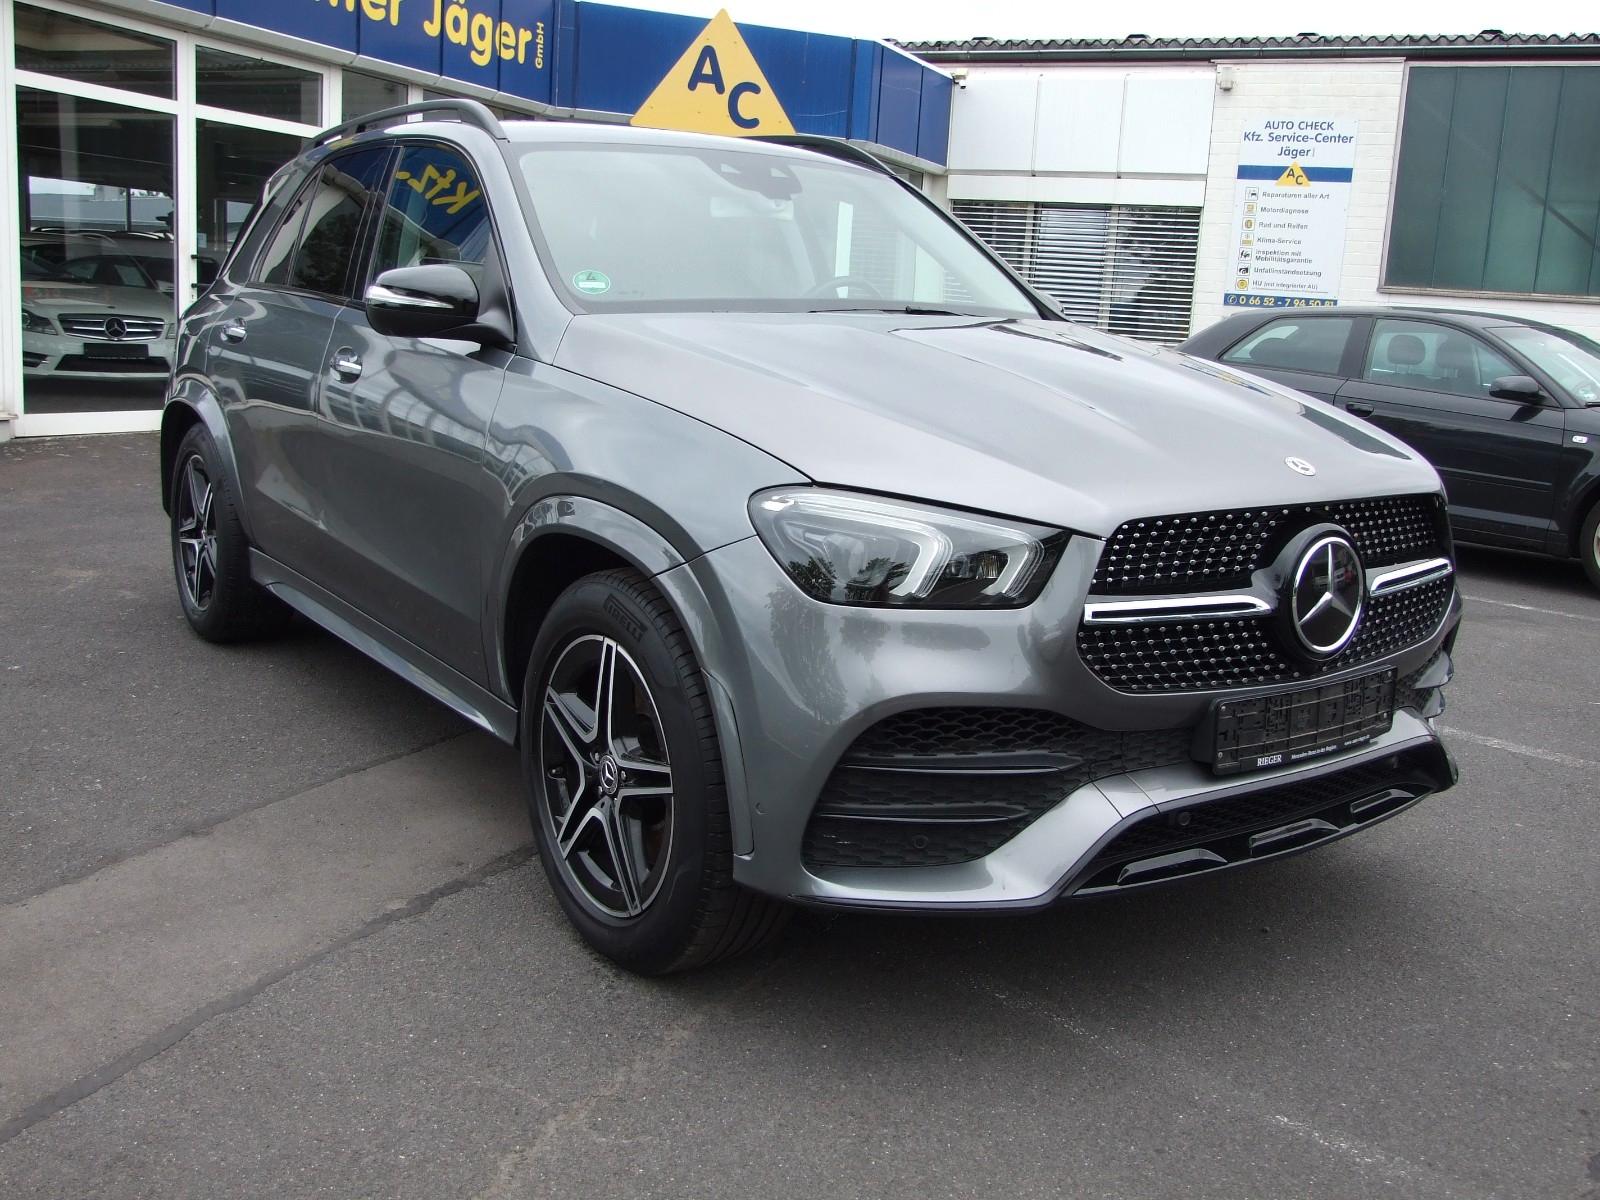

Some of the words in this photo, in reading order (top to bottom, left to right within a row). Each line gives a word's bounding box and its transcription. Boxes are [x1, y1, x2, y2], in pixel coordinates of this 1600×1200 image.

[423, 0, 532, 66] Jäger
[535, 22, 545, 69] GmbH
[1264, 121, 1294, 130] AUTO
[1298, 121, 1334, 131] CHECK
[1243, 131, 1264, 142] Kfz.
[1267, 132, 1354, 144] Service-Center
[1277, 146, 1311, 159] Jäger
[1262, 191, 1302, 200] Reparaturen
[1260, 206, 1309, 215] Motordiagnose
[1257, 237, 1302, 245] Klima-Service
[1254, 267, 1322, 277] Unfallinstandsetzung
[1239, 296, 1246, 304] 0
[1249, 296, 1260, 305] 66
[1263, 297, 1275, 305] 52
[1257, 754, 1282, 767] RIEGER
